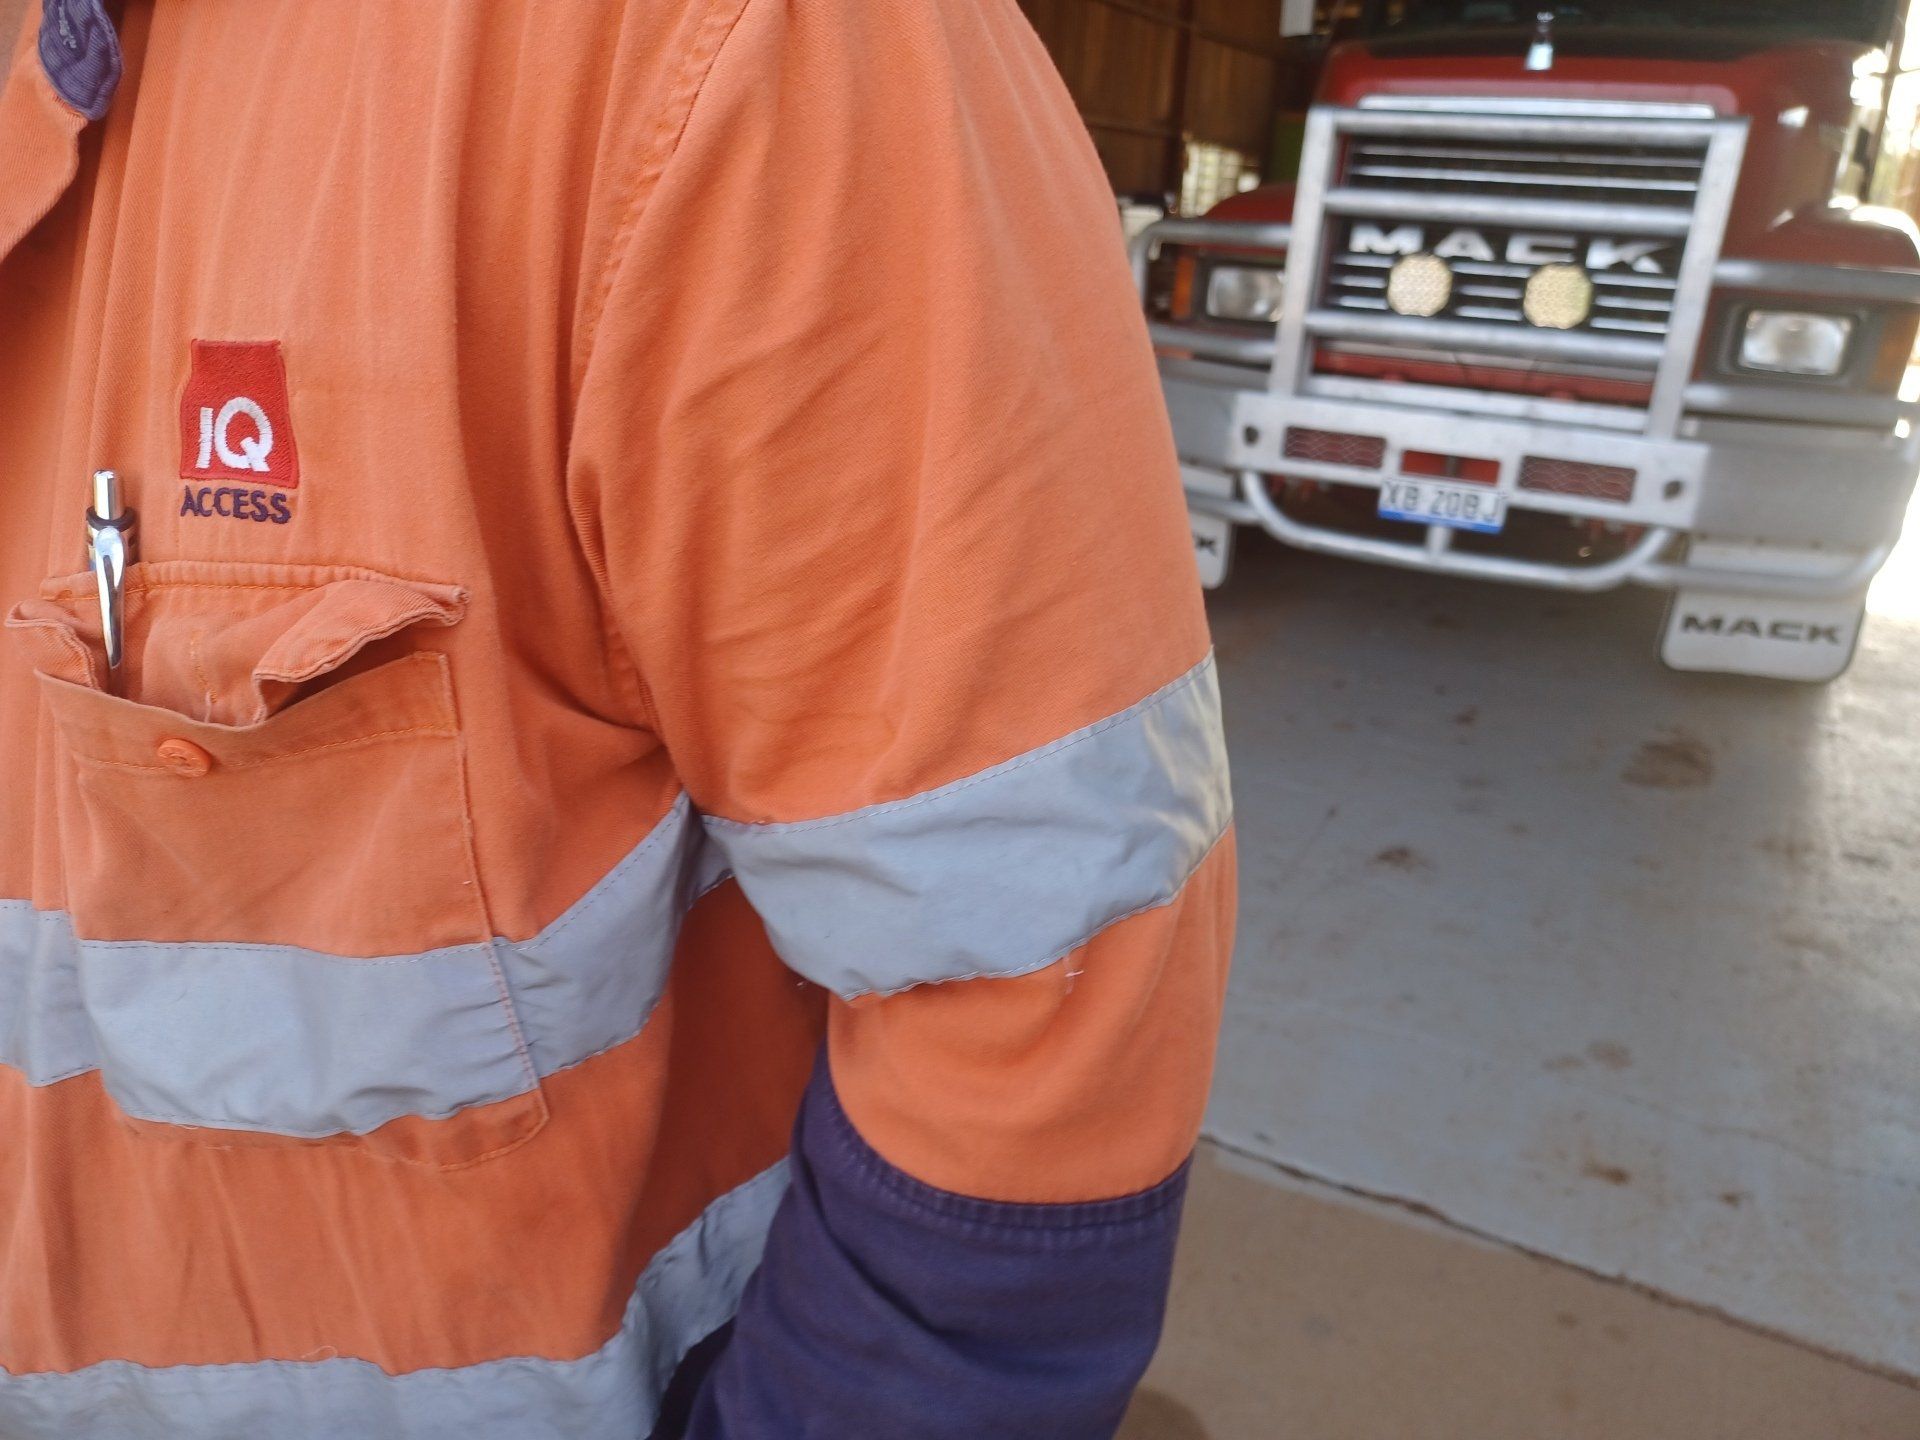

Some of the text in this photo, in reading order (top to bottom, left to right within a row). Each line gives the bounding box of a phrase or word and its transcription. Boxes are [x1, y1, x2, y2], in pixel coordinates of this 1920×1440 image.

[1349, 224, 1668, 274] MACK
[195, 397, 273, 471] IQ
[180, 485, 291, 524] ACCESS
[1682, 614, 1841, 645] MACK
